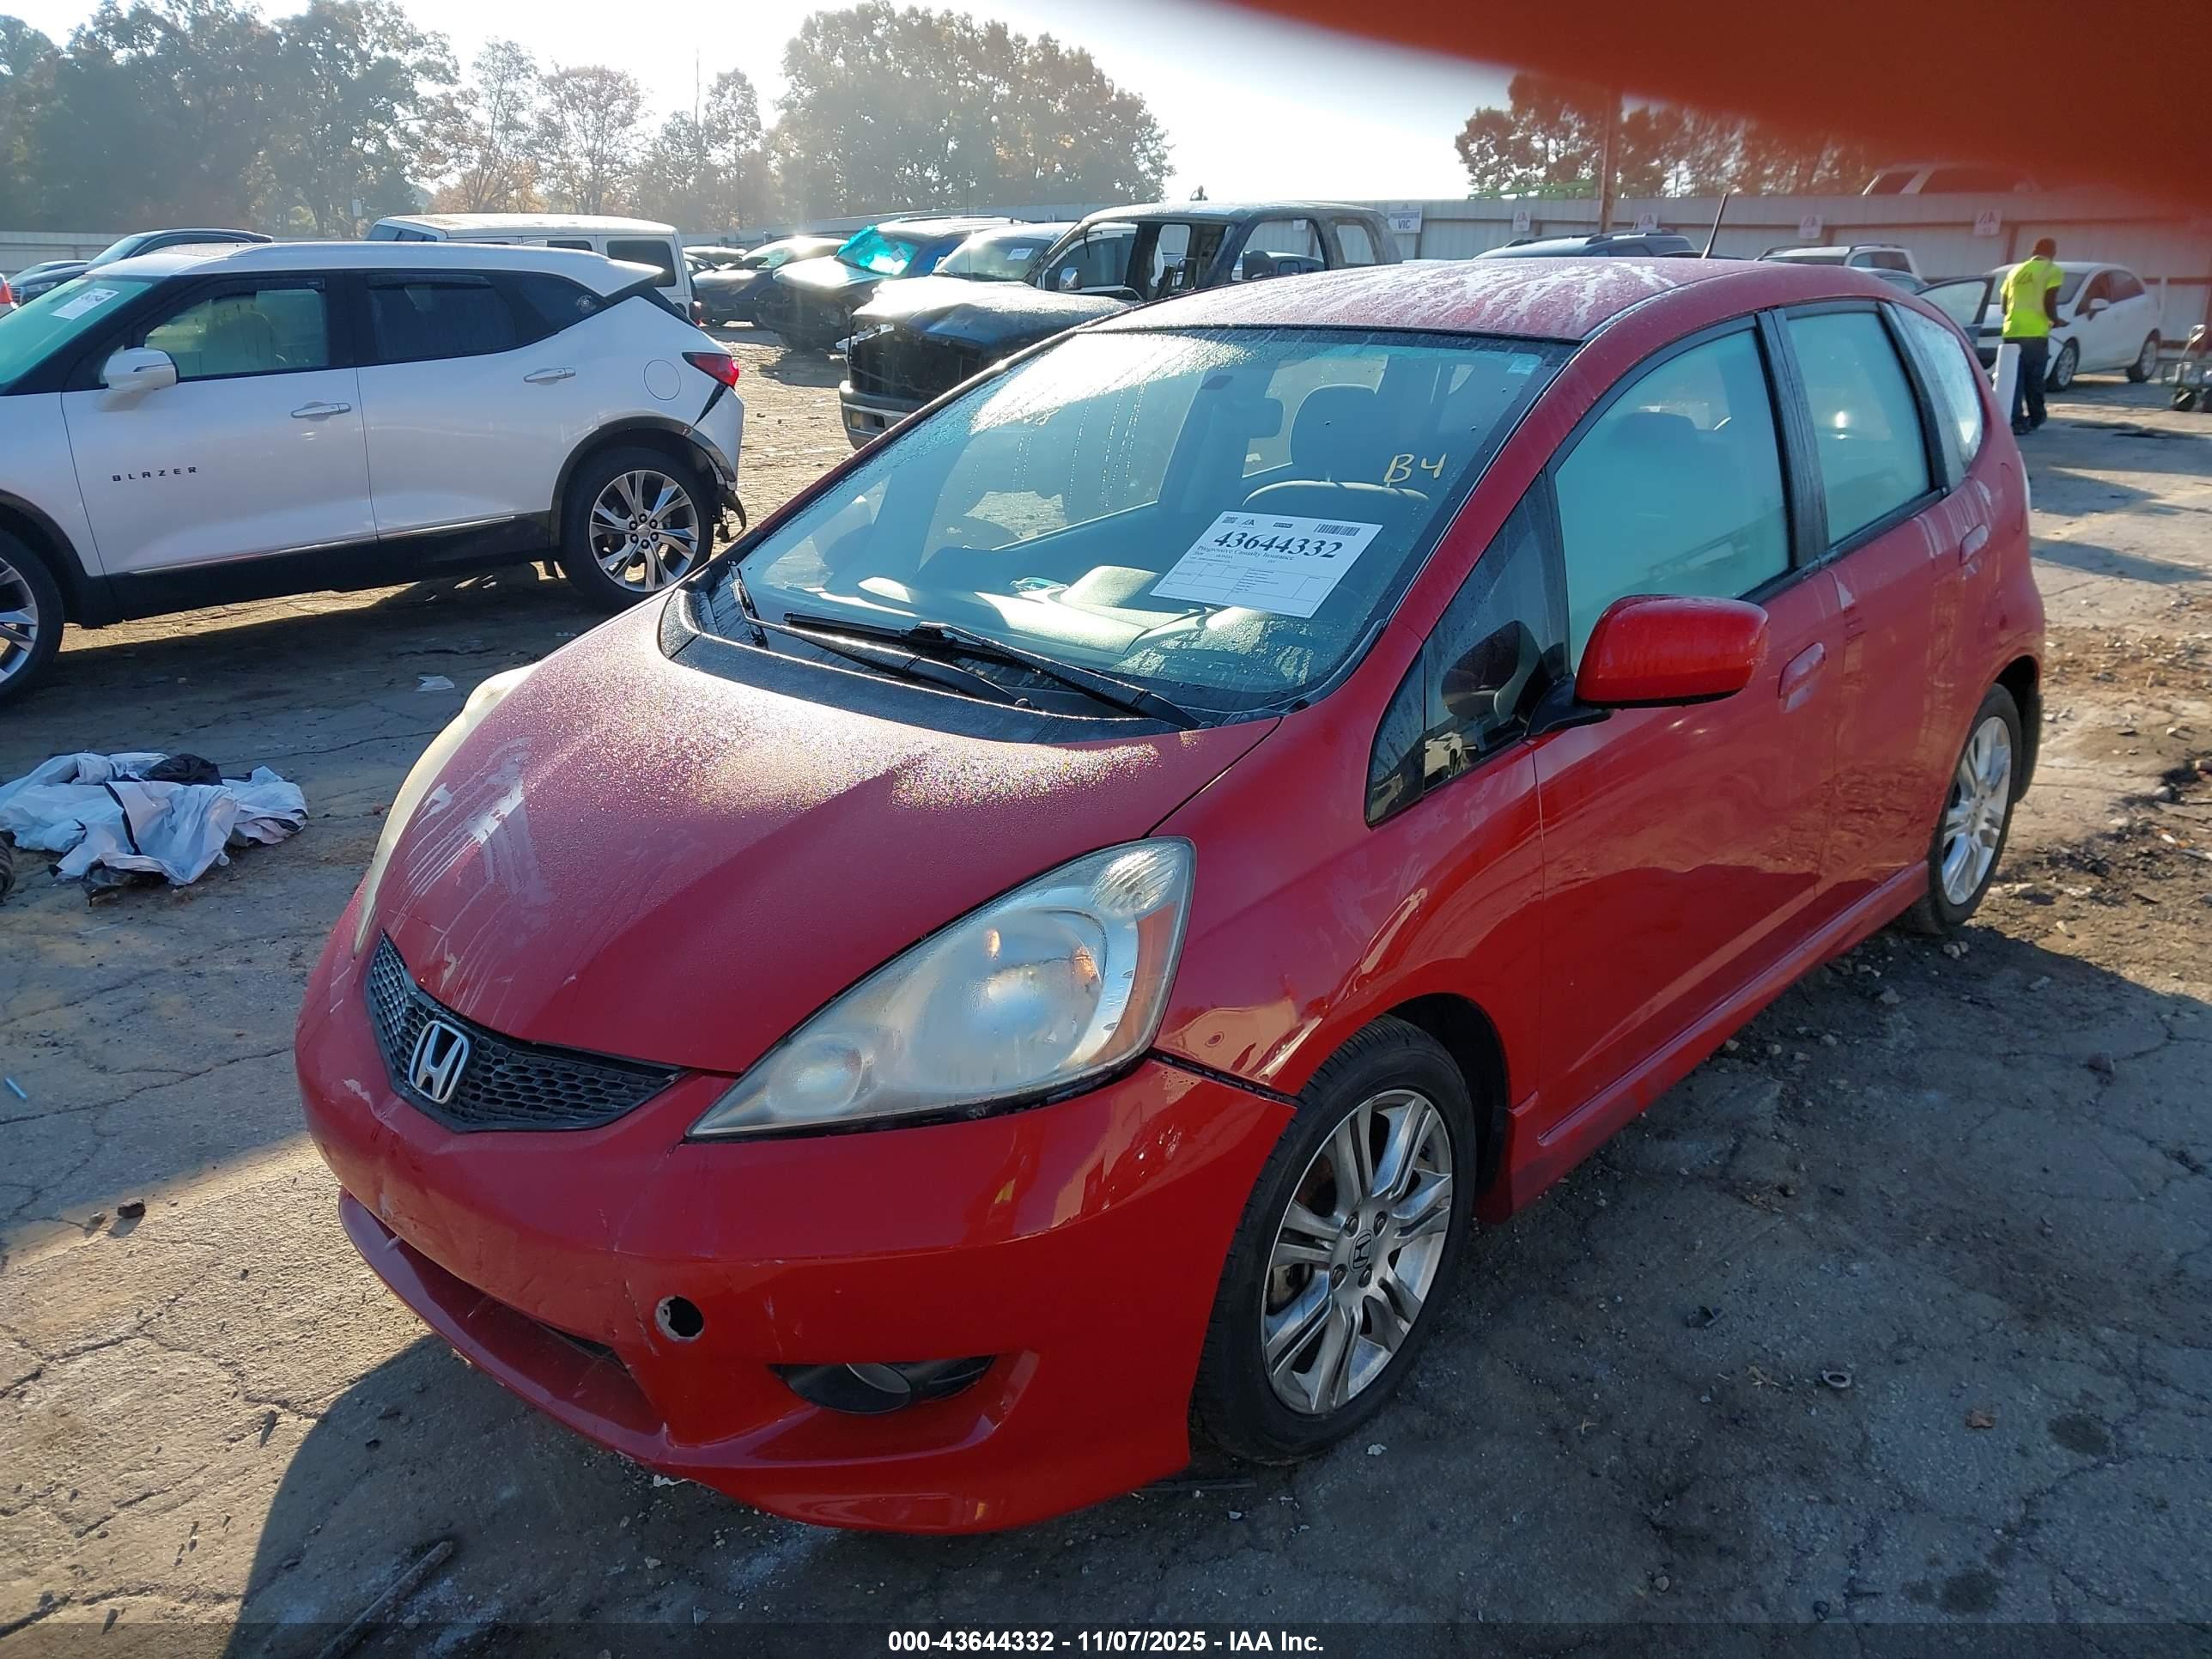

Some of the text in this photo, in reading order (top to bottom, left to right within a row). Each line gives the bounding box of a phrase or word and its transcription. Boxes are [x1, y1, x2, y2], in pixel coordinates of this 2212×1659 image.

[1398, 219, 1411, 229] VIC
[112, 466, 198, 482] BLAZER
[1214, 531, 1343, 558] 43644332
[1197, 545, 1234, 554] Progressive
[1234, 550, 1261, 558] Casualty
[1263, 552, 1296, 561] Insurance
